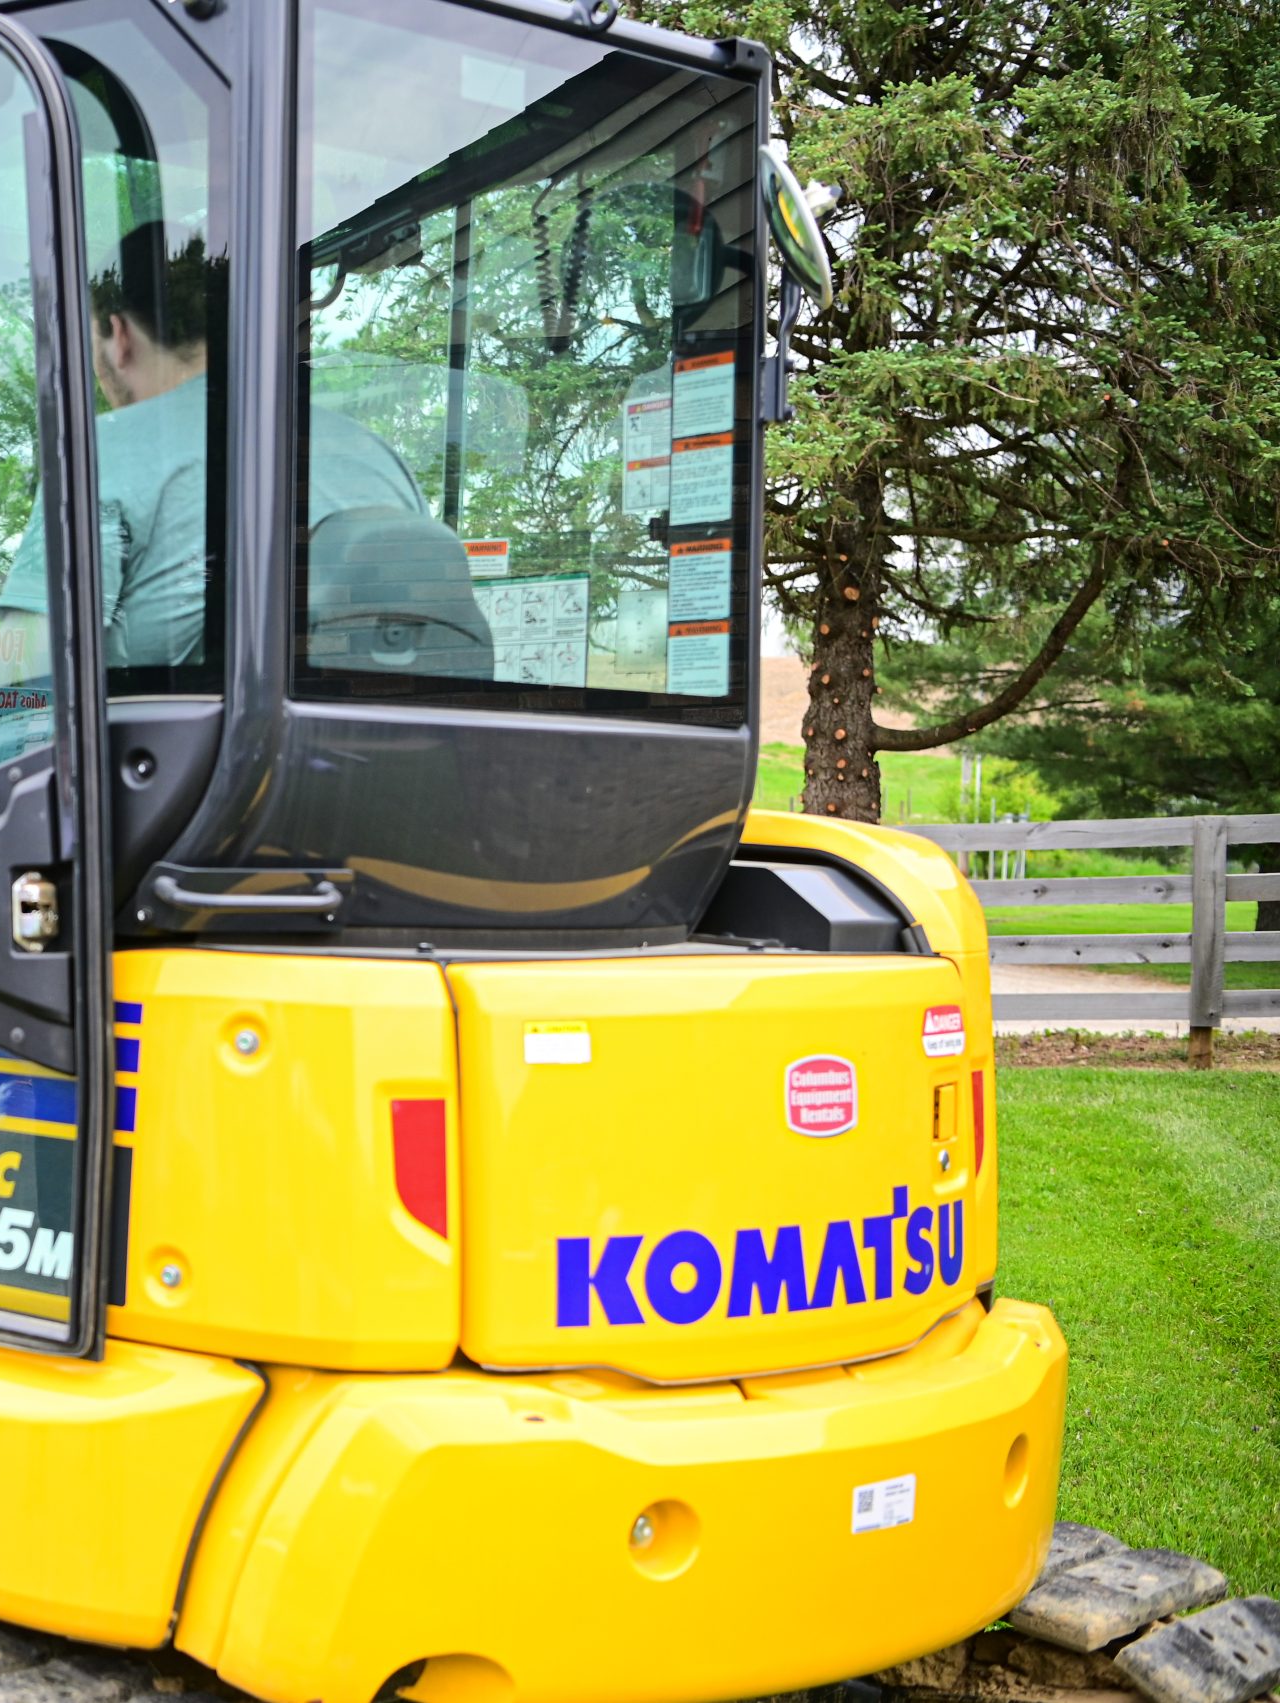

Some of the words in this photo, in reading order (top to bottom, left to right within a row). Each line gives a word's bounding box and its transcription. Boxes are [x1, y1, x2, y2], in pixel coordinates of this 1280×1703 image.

[468, 543, 503, 553] WARNING
[933, 1012, 961, 1032] DANGER
[791, 1069, 850, 1088] Columbus
[790, 1088, 852, 1107] Equipment
[800, 1106, 846, 1124] Rentals
[556, 1185, 964, 1328] KOMATSU
